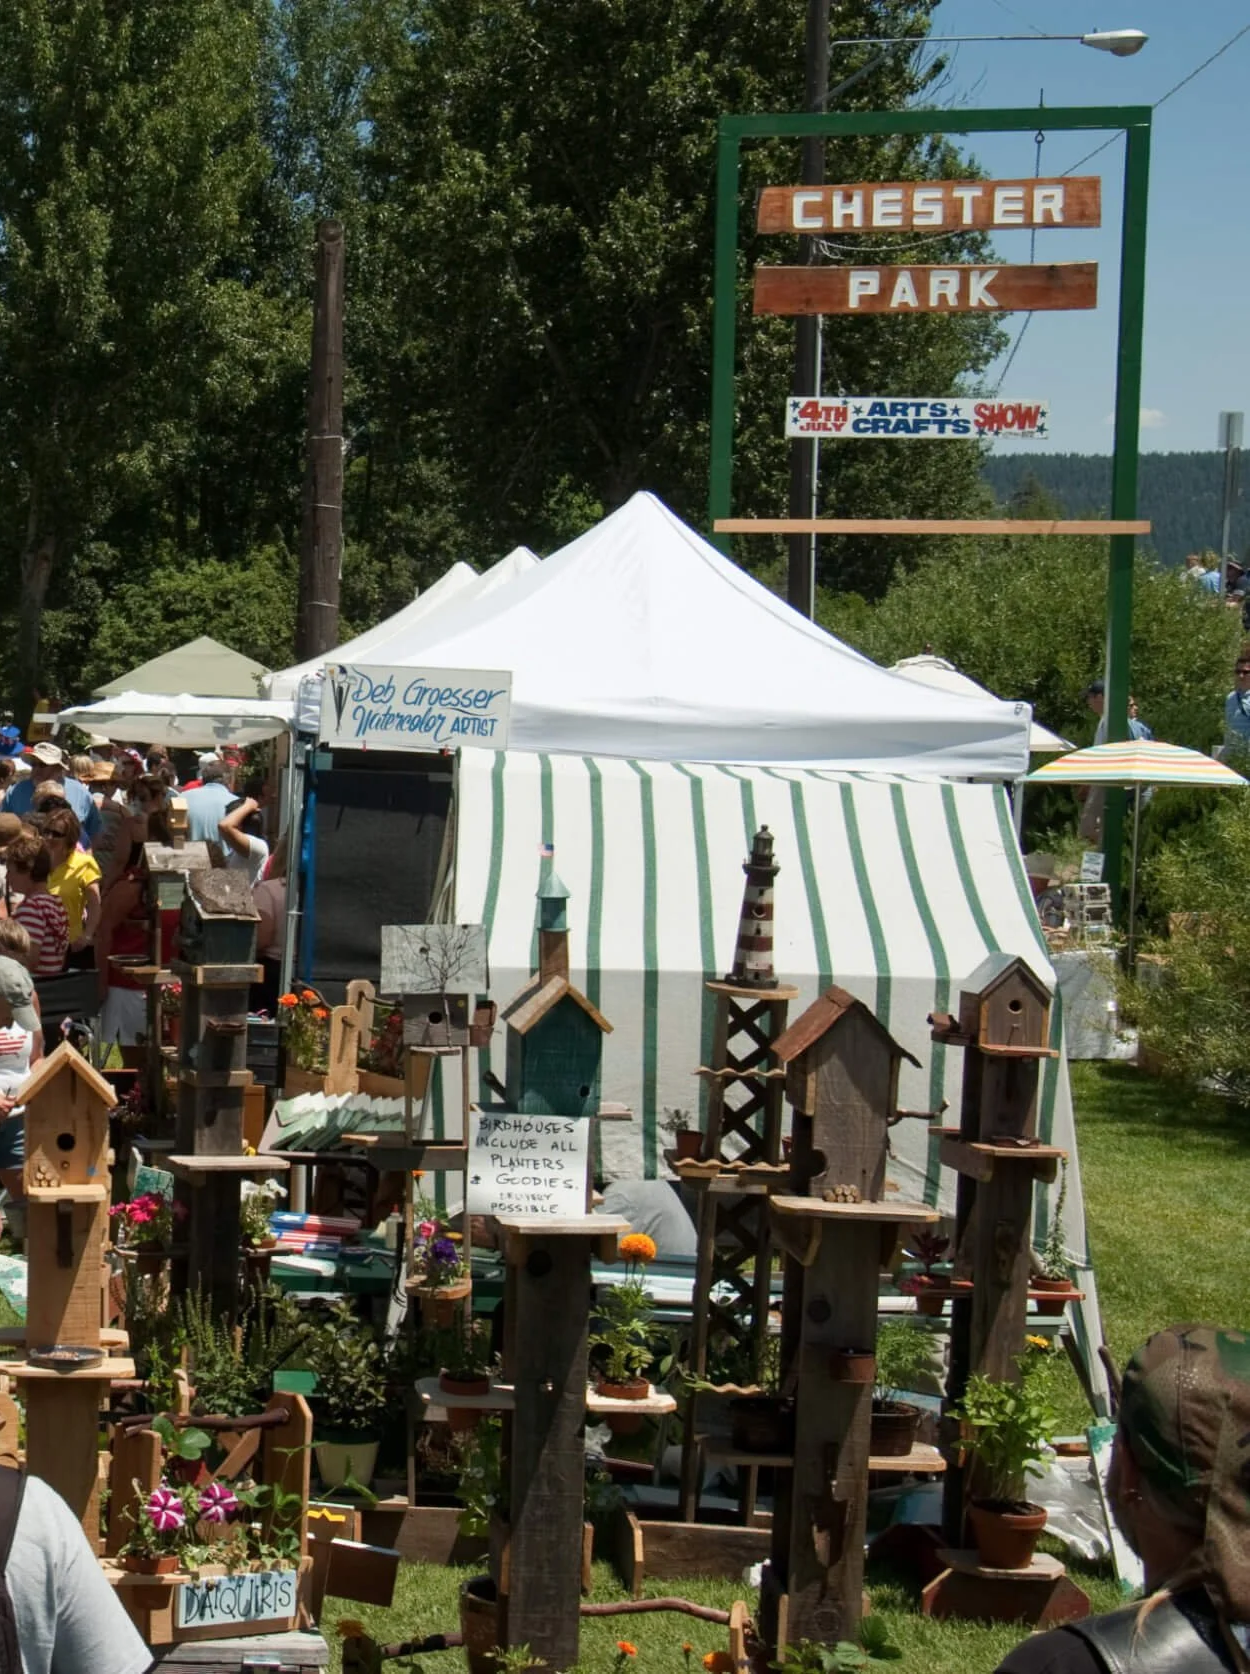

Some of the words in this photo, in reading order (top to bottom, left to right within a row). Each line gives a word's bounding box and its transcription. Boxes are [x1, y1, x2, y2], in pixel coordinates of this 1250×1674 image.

[792, 184, 1065, 229] CHESTER
[849, 269, 999, 308] PARK
[798, 401, 848, 422] 4TH
[867, 402, 948, 417] ARTS
[973, 402, 1042, 432] SHOW
[799, 422, 846, 432] JULY
[852, 418, 971, 434] CRAFTS
[351, 666, 396, 704] Deb
[403, 678, 507, 710] Groesser
[352, 705, 453, 743] Watercolor
[450, 716, 499, 737] ARTIST
[479, 1117, 575, 1134] BIRDHOUSES
[475, 1137, 539, 1150] INCLUDE
[551, 1141, 578, 1152] ALL
[490, 1154, 565, 1170] PLANTERS
[184, 1578, 292, 1624] DAIQUIRIS
